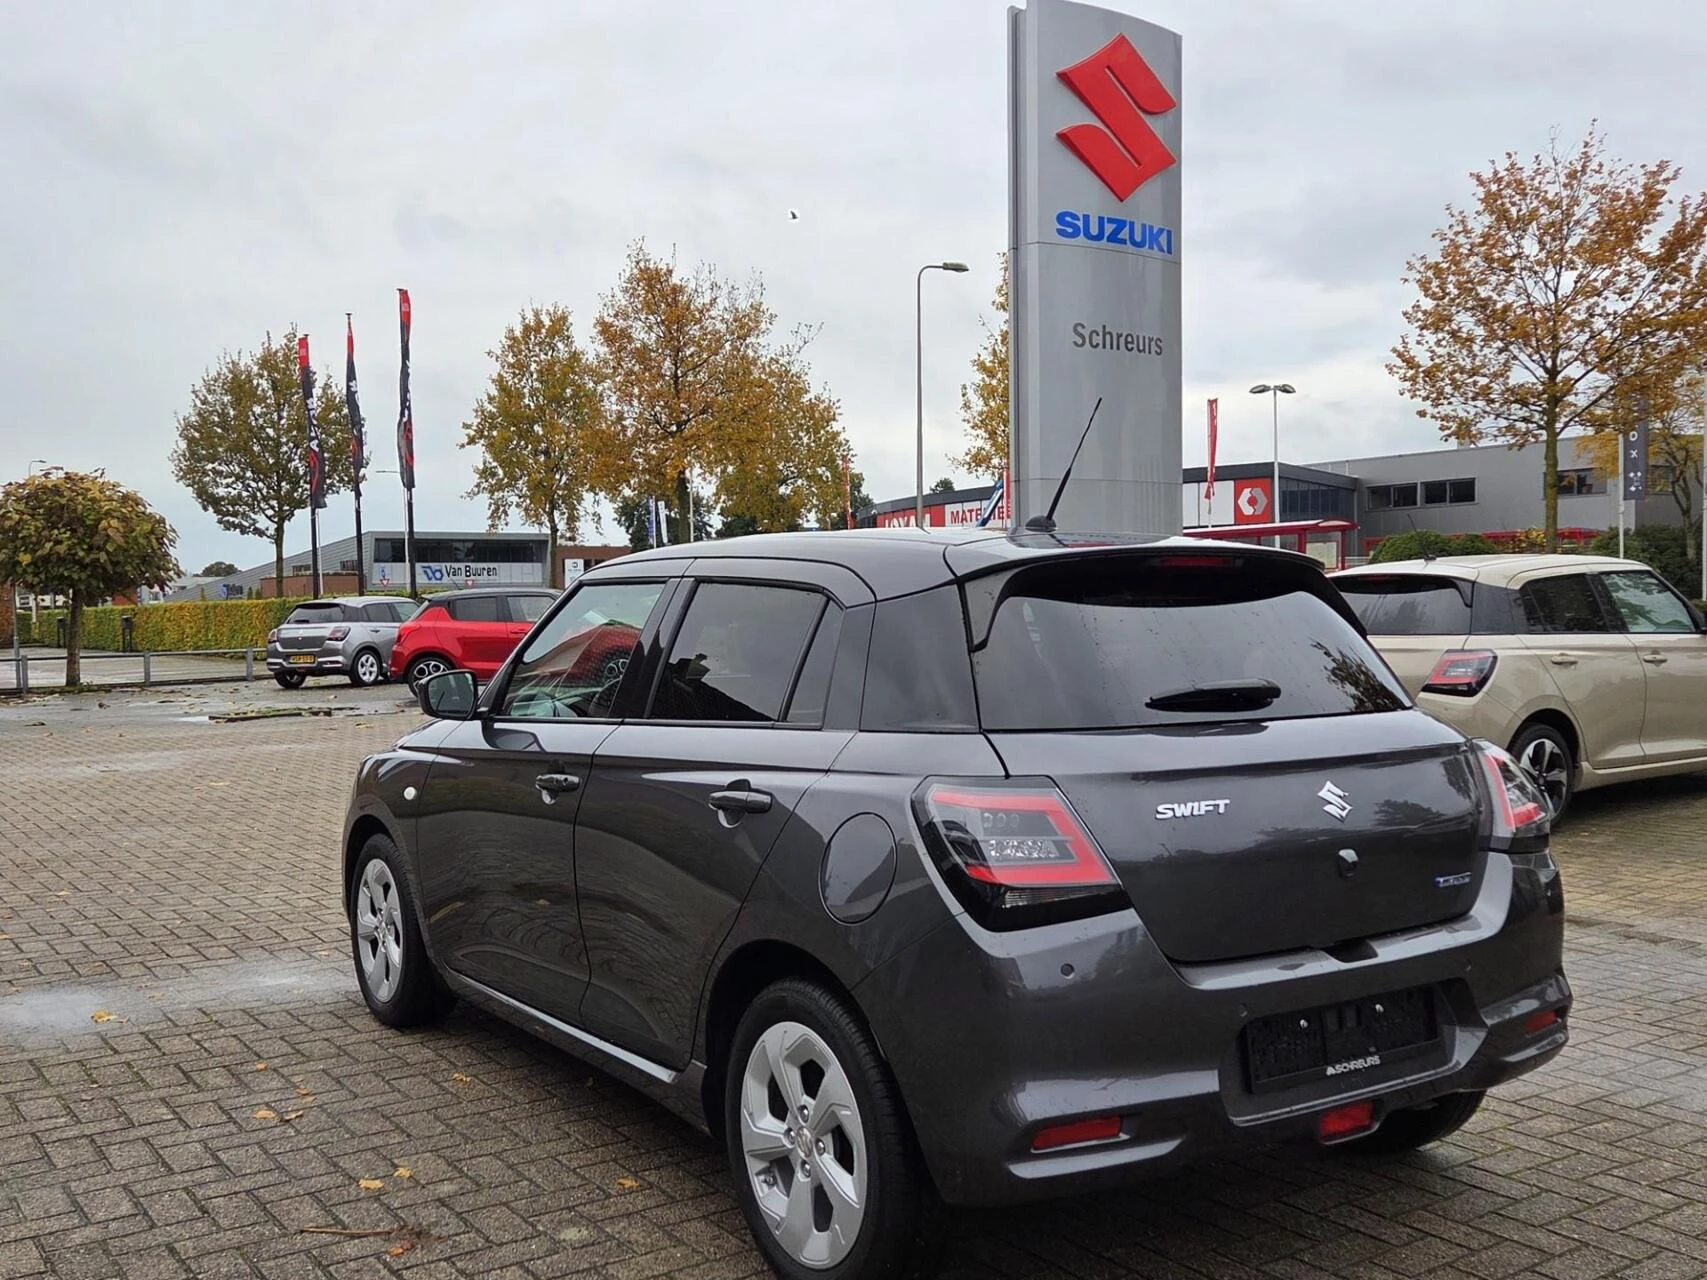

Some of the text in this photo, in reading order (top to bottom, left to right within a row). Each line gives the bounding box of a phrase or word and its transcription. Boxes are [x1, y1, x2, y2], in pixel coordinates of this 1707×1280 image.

[1055, 210, 1173, 255] SUZUKI
[1072, 322, 1163, 356] Schreurs
[445, 564, 498, 578] Van Buuren
[1155, 798, 1231, 819] SWIFT
